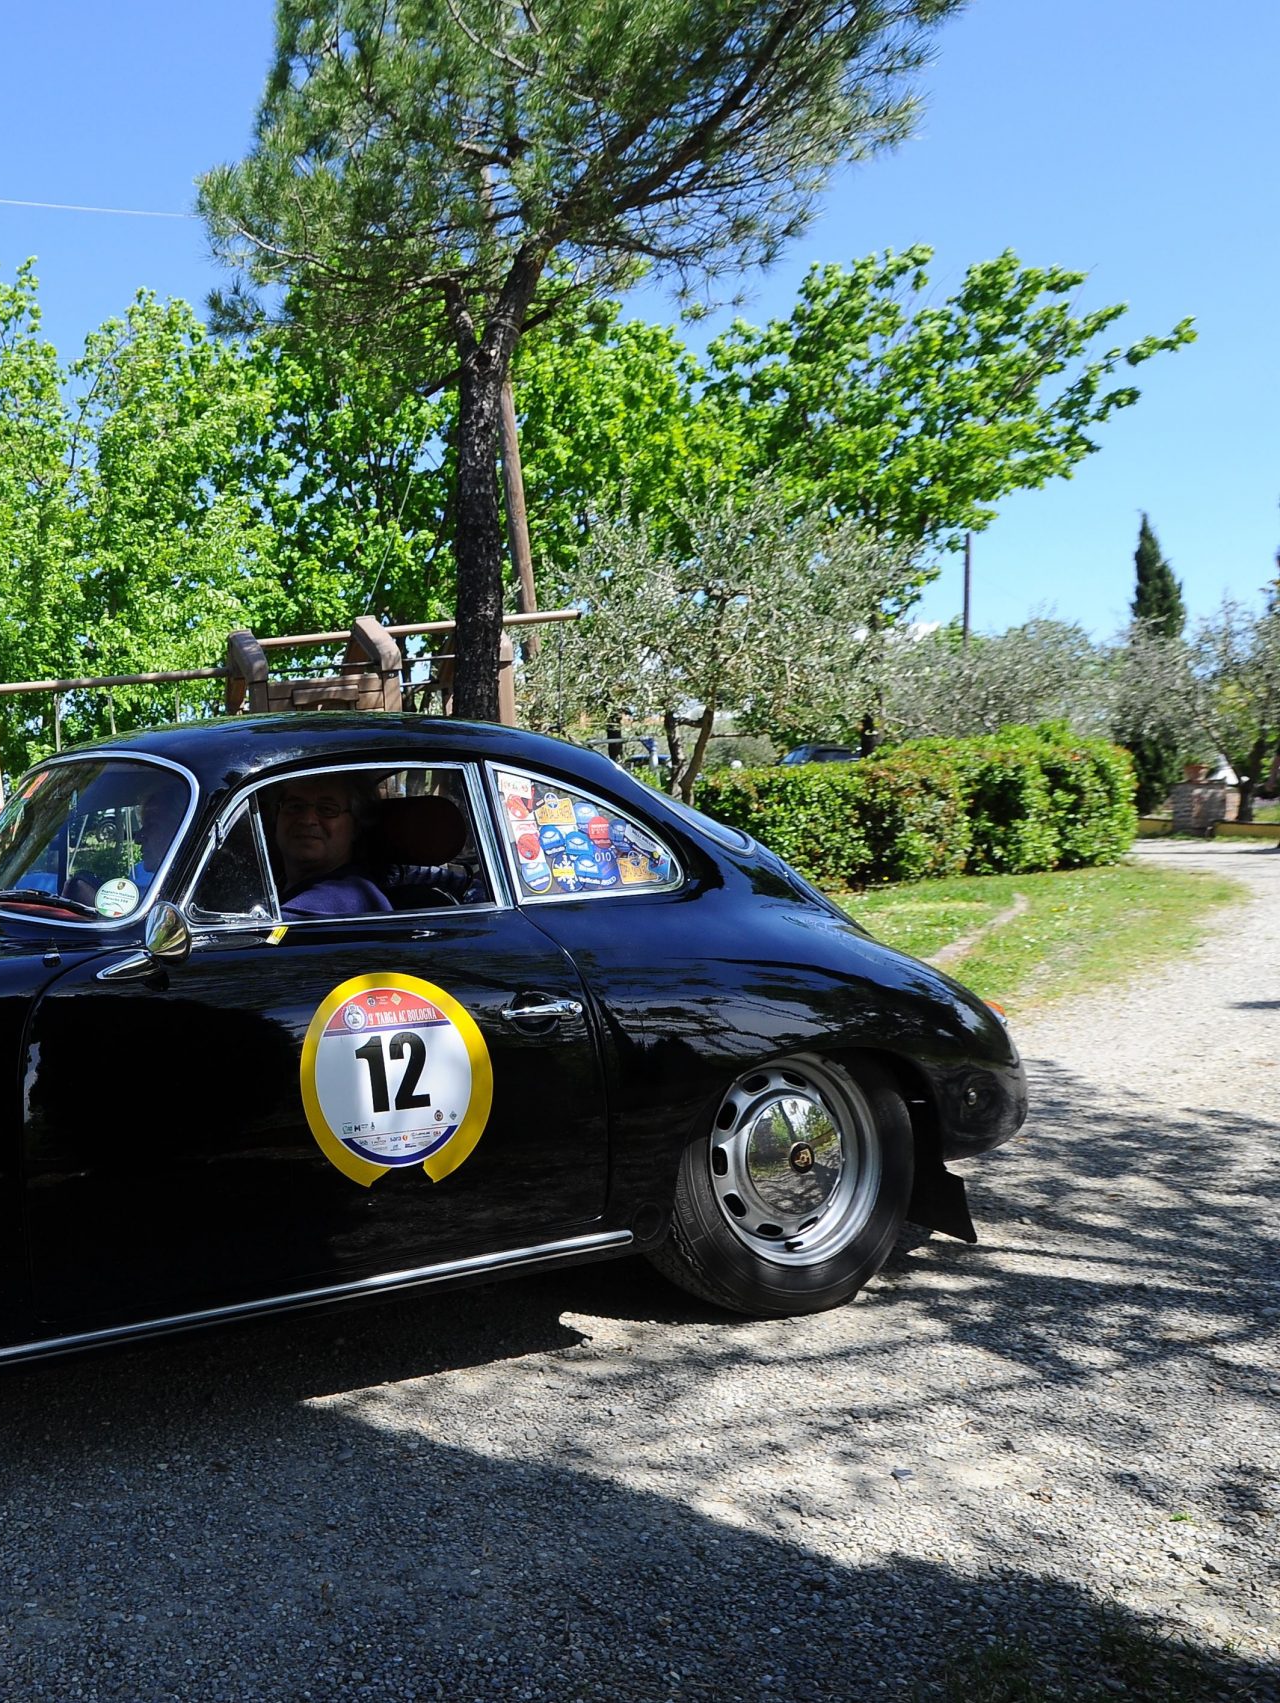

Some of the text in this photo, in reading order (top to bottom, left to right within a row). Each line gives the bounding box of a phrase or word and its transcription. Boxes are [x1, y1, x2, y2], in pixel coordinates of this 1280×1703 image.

[376, 1012, 398, 1024] TARGA
[398, 1011, 407, 1022] AC
[407, 1007, 438, 1021] BOLOGNA
[355, 1031, 431, 1113] 12
